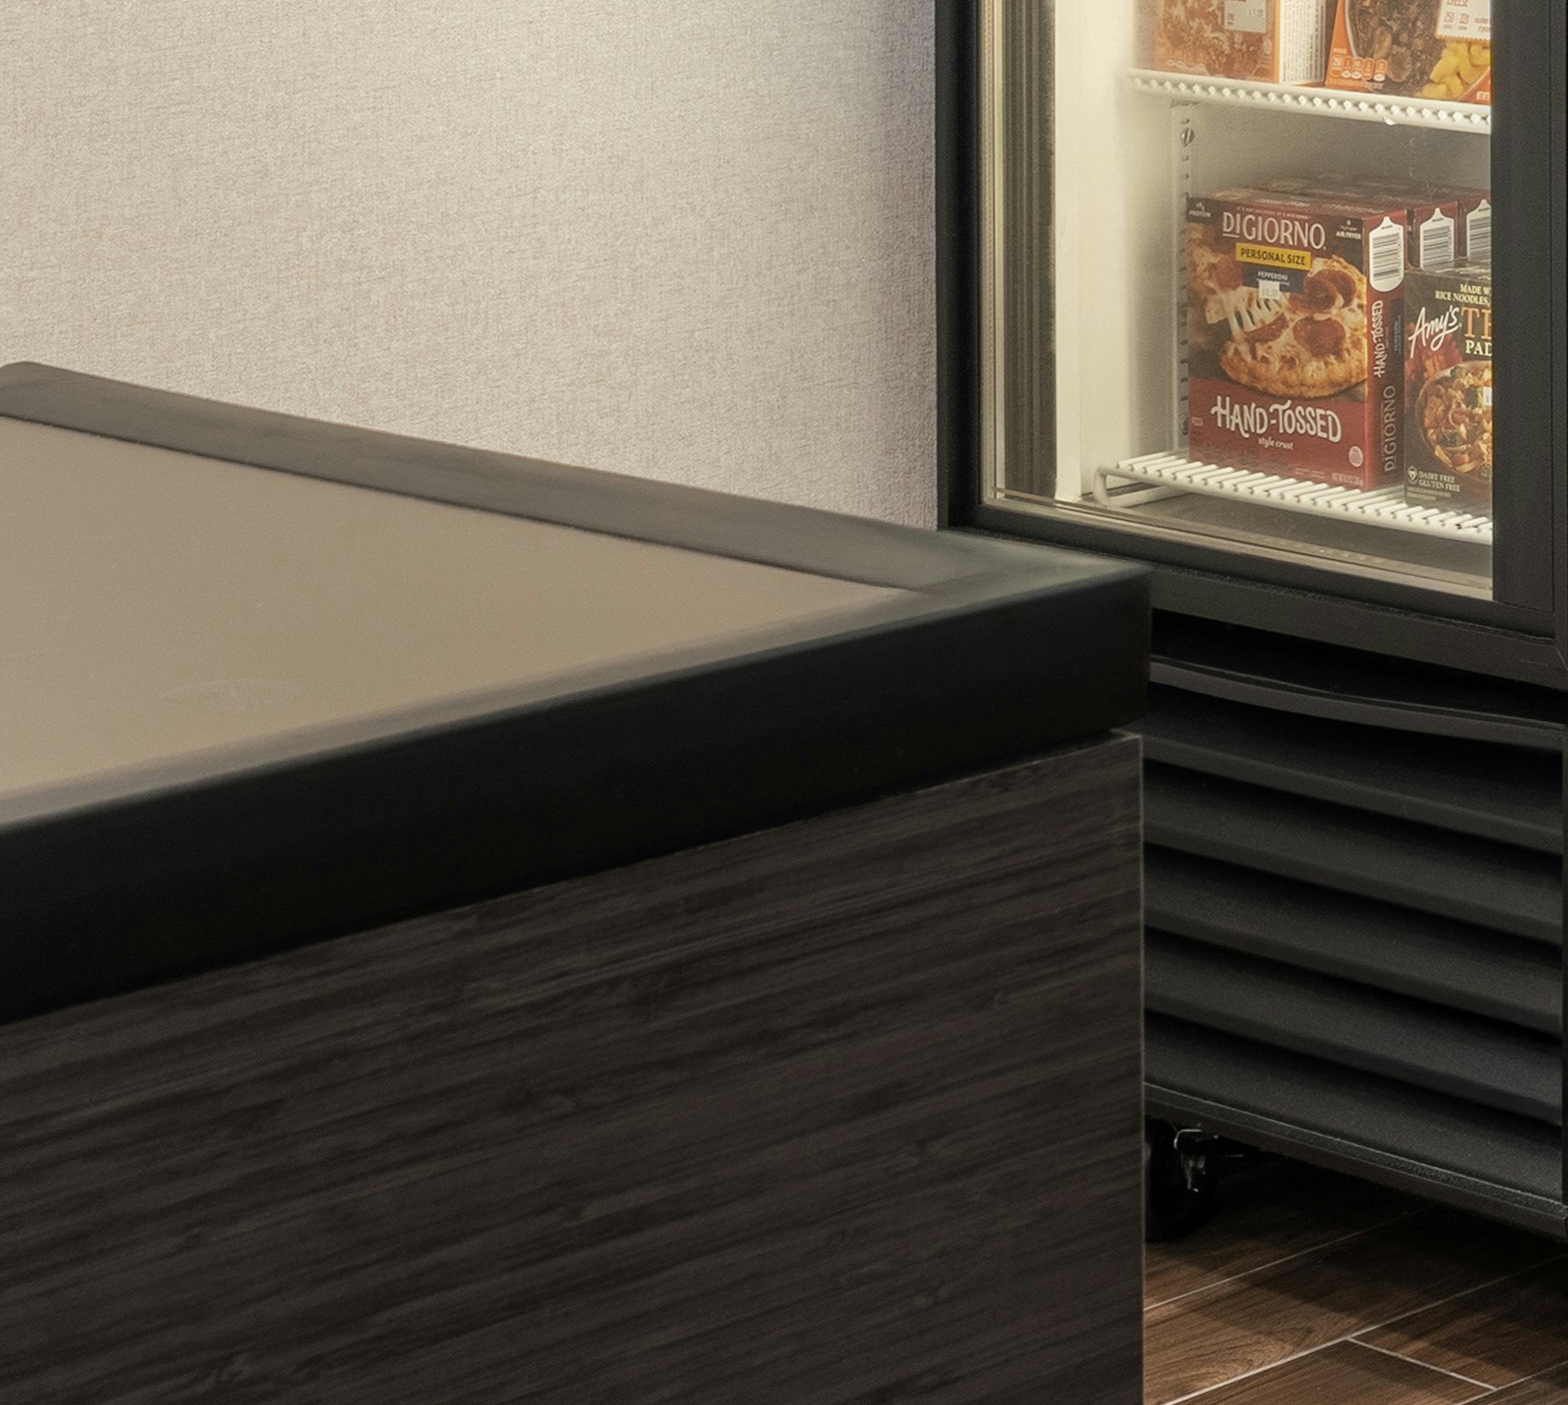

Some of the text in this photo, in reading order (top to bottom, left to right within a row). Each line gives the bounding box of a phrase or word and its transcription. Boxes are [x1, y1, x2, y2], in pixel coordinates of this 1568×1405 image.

[1240, 247, 1306, 267] PERSONAL SIZE
[1435, 290, 1452, 300] RICE
[1408, 305, 1459, 359] Amy's
[1211, 395, 1342, 443] HAND-TOSSED
[1418, 478, 1443, 491] GLUTEN
[1439, 473, 1455, 484] FREE
